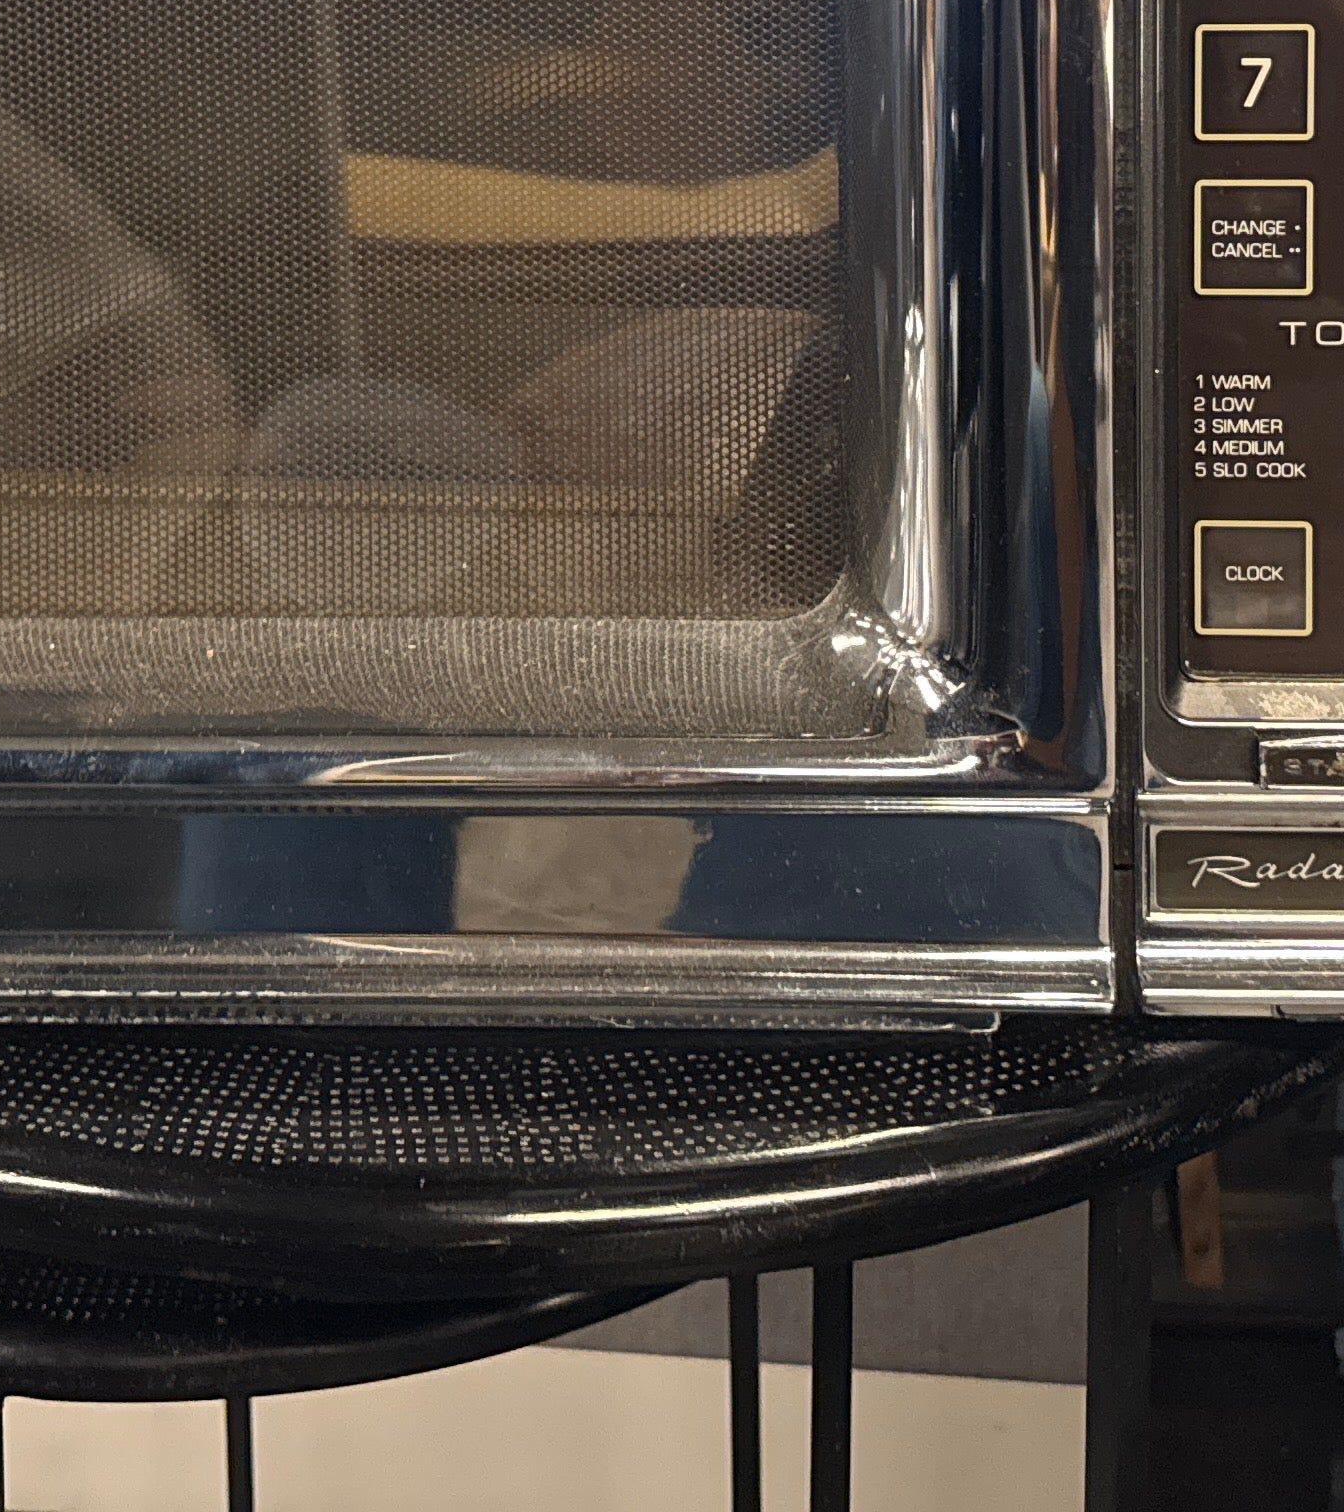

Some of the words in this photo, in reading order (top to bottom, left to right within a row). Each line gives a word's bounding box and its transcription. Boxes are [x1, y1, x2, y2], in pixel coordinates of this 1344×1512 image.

[1239, 56, 1273, 108] 7
[1211, 219, 1286, 236] CHANGE
[1211, 242, 1283, 259] CANCEL
[1196, 374, 1204, 389] 1
[1211, 374, 1271, 390] WARM
[1193, 396, 1206, 412] 2
[1212, 396, 1255, 412] LOW
[1193, 418, 1206, 434] 3
[1212, 418, 1283, 434] SIMMER
[1194, 439, 1207, 455] 4
[1212, 439, 1284, 456] MEDIUM
[1194, 461, 1207, 478] 5
[1213, 462, 1247, 478] SLO
[1256, 462, 1307, 478] COOK
[1225, 565, 1284, 582] CLOCK
